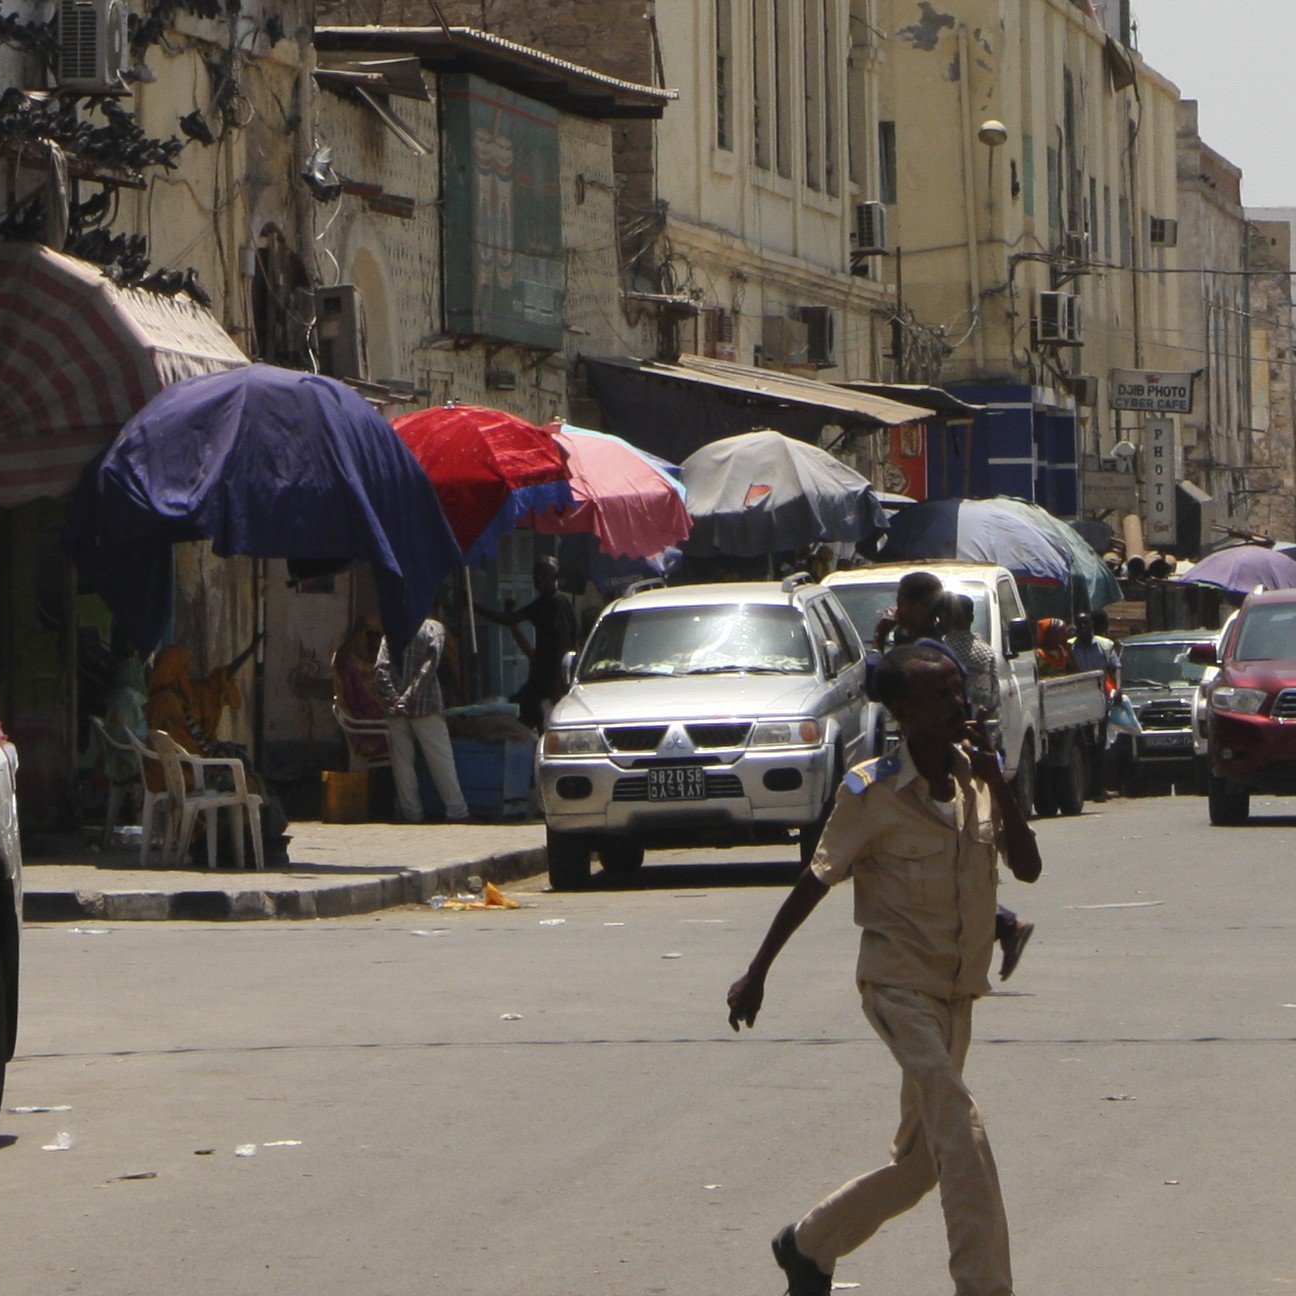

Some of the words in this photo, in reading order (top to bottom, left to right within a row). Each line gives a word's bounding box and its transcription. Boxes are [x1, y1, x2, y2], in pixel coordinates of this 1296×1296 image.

[1147, 386, 1186, 398] PHOTO
[1115, 396, 1154, 408] CYBER
[1154, 428, 1164, 512] PHOTO
